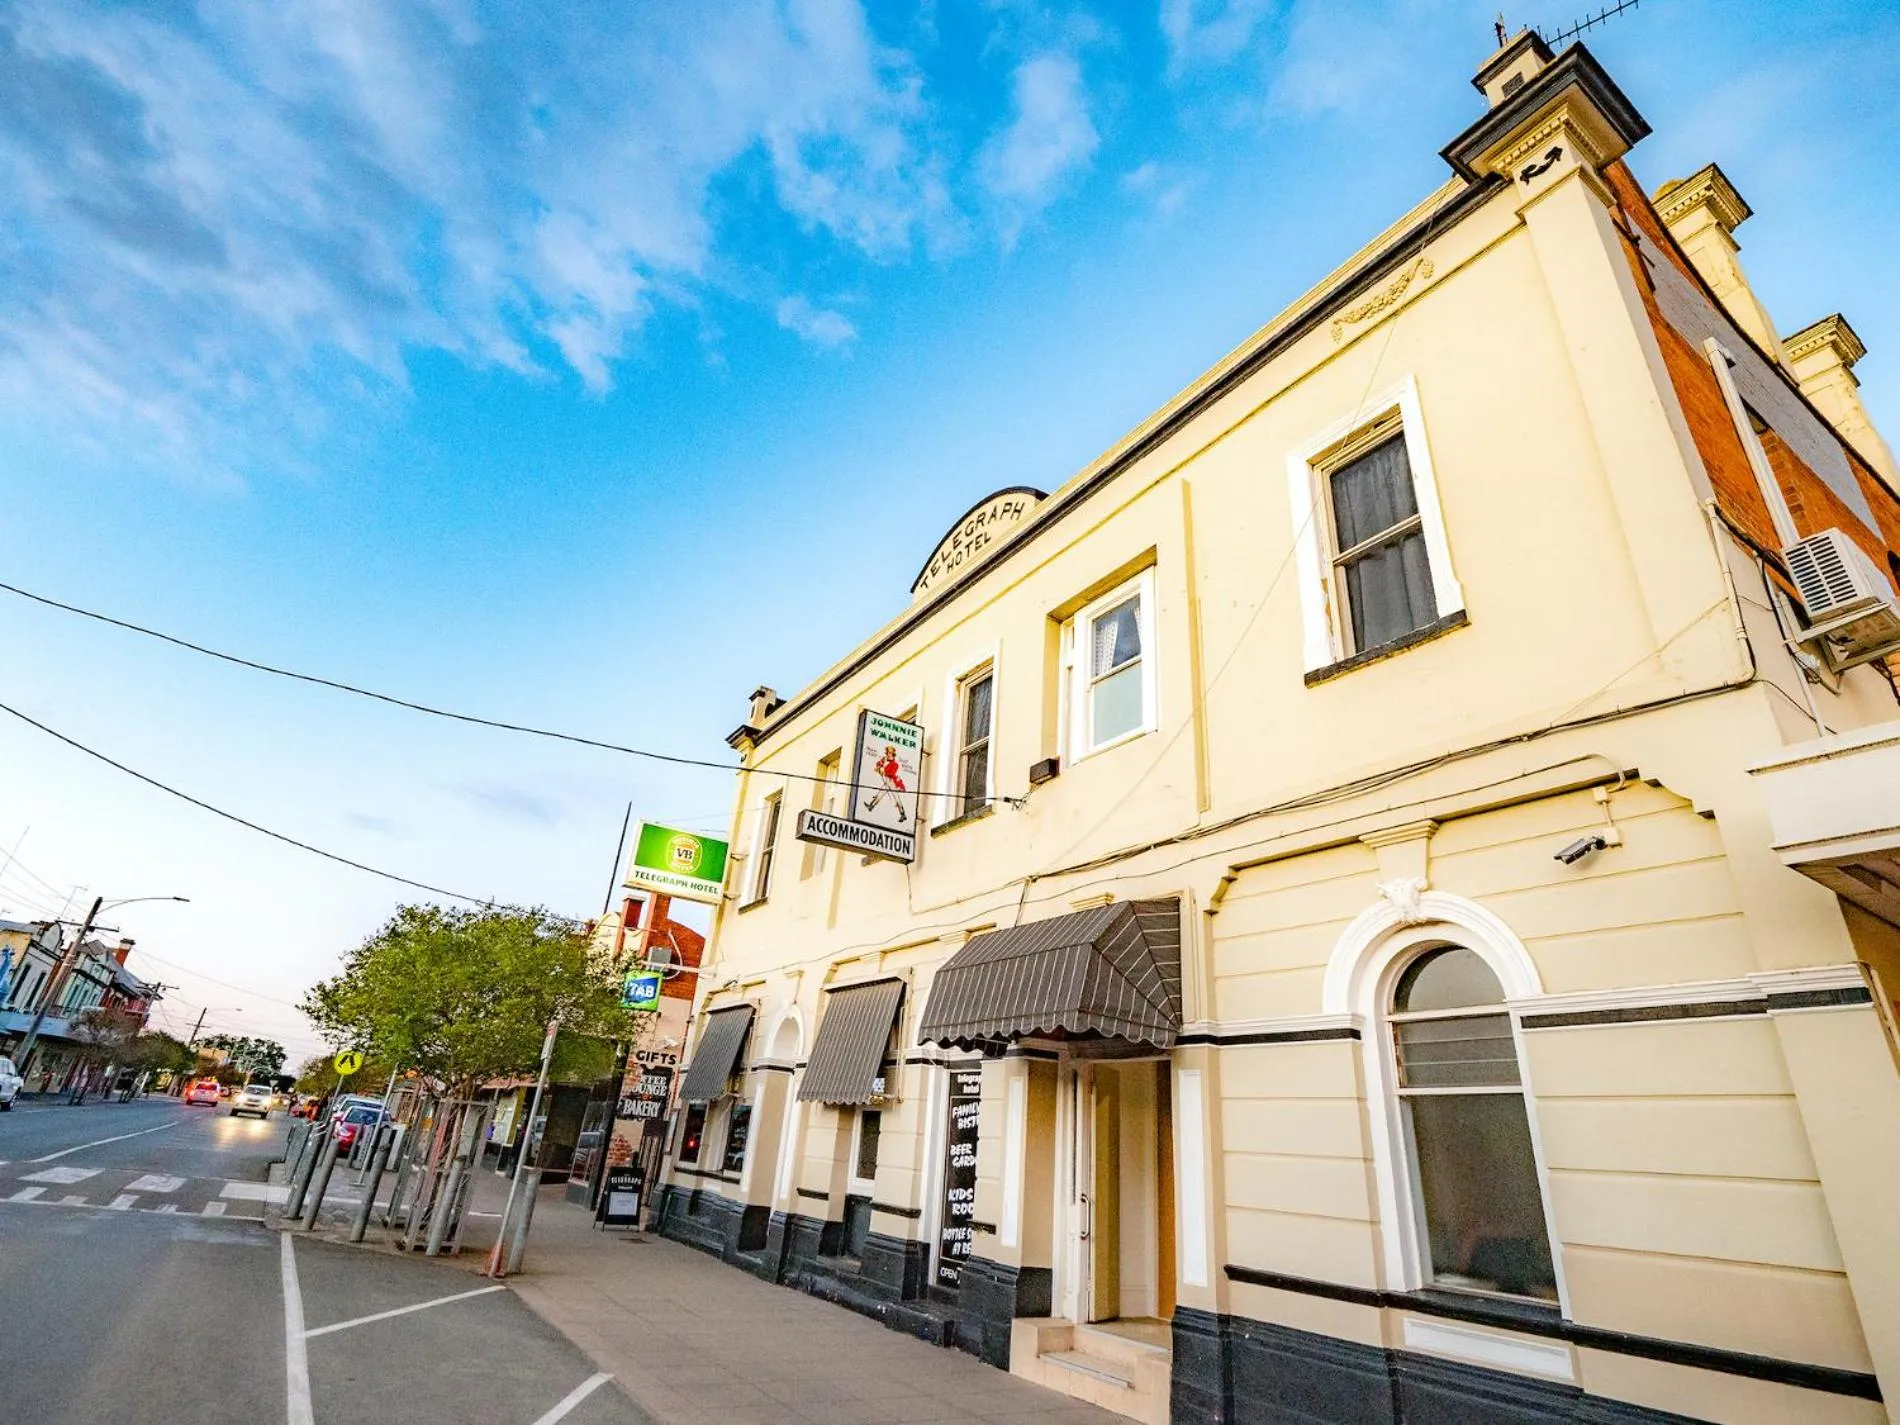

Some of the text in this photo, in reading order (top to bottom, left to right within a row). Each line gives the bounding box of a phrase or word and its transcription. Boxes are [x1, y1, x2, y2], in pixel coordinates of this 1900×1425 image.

[920, 502, 1025, 589] TELEGRAPH
[946, 532, 991, 573] HOTEL
[871, 717, 917, 738] JOHNNIE
[870, 728, 916, 748] WALKER
[807, 815, 911, 855] ACCOMMODATION
[677, 847, 693, 860] VB
[634, 870, 719, 894] TELEGRAPH HOTEL
[629, 981, 655, 998] TAB
[636, 1050, 677, 1065] GIFTS
[632, 1083, 667, 1097] OUNGE
[622, 1099, 661, 1118] BAKERY
[950, 1143, 972, 1156] BEER
[952, 1154, 977, 1168] GARD
[948, 1187, 974, 1202] KIDS
[951, 1202, 974, 1216] ROO
[943, 1227, 966, 1241] BOTTLE
[962, 1243, 973, 1255] RE
[940, 1267, 957, 1280] OPEN
